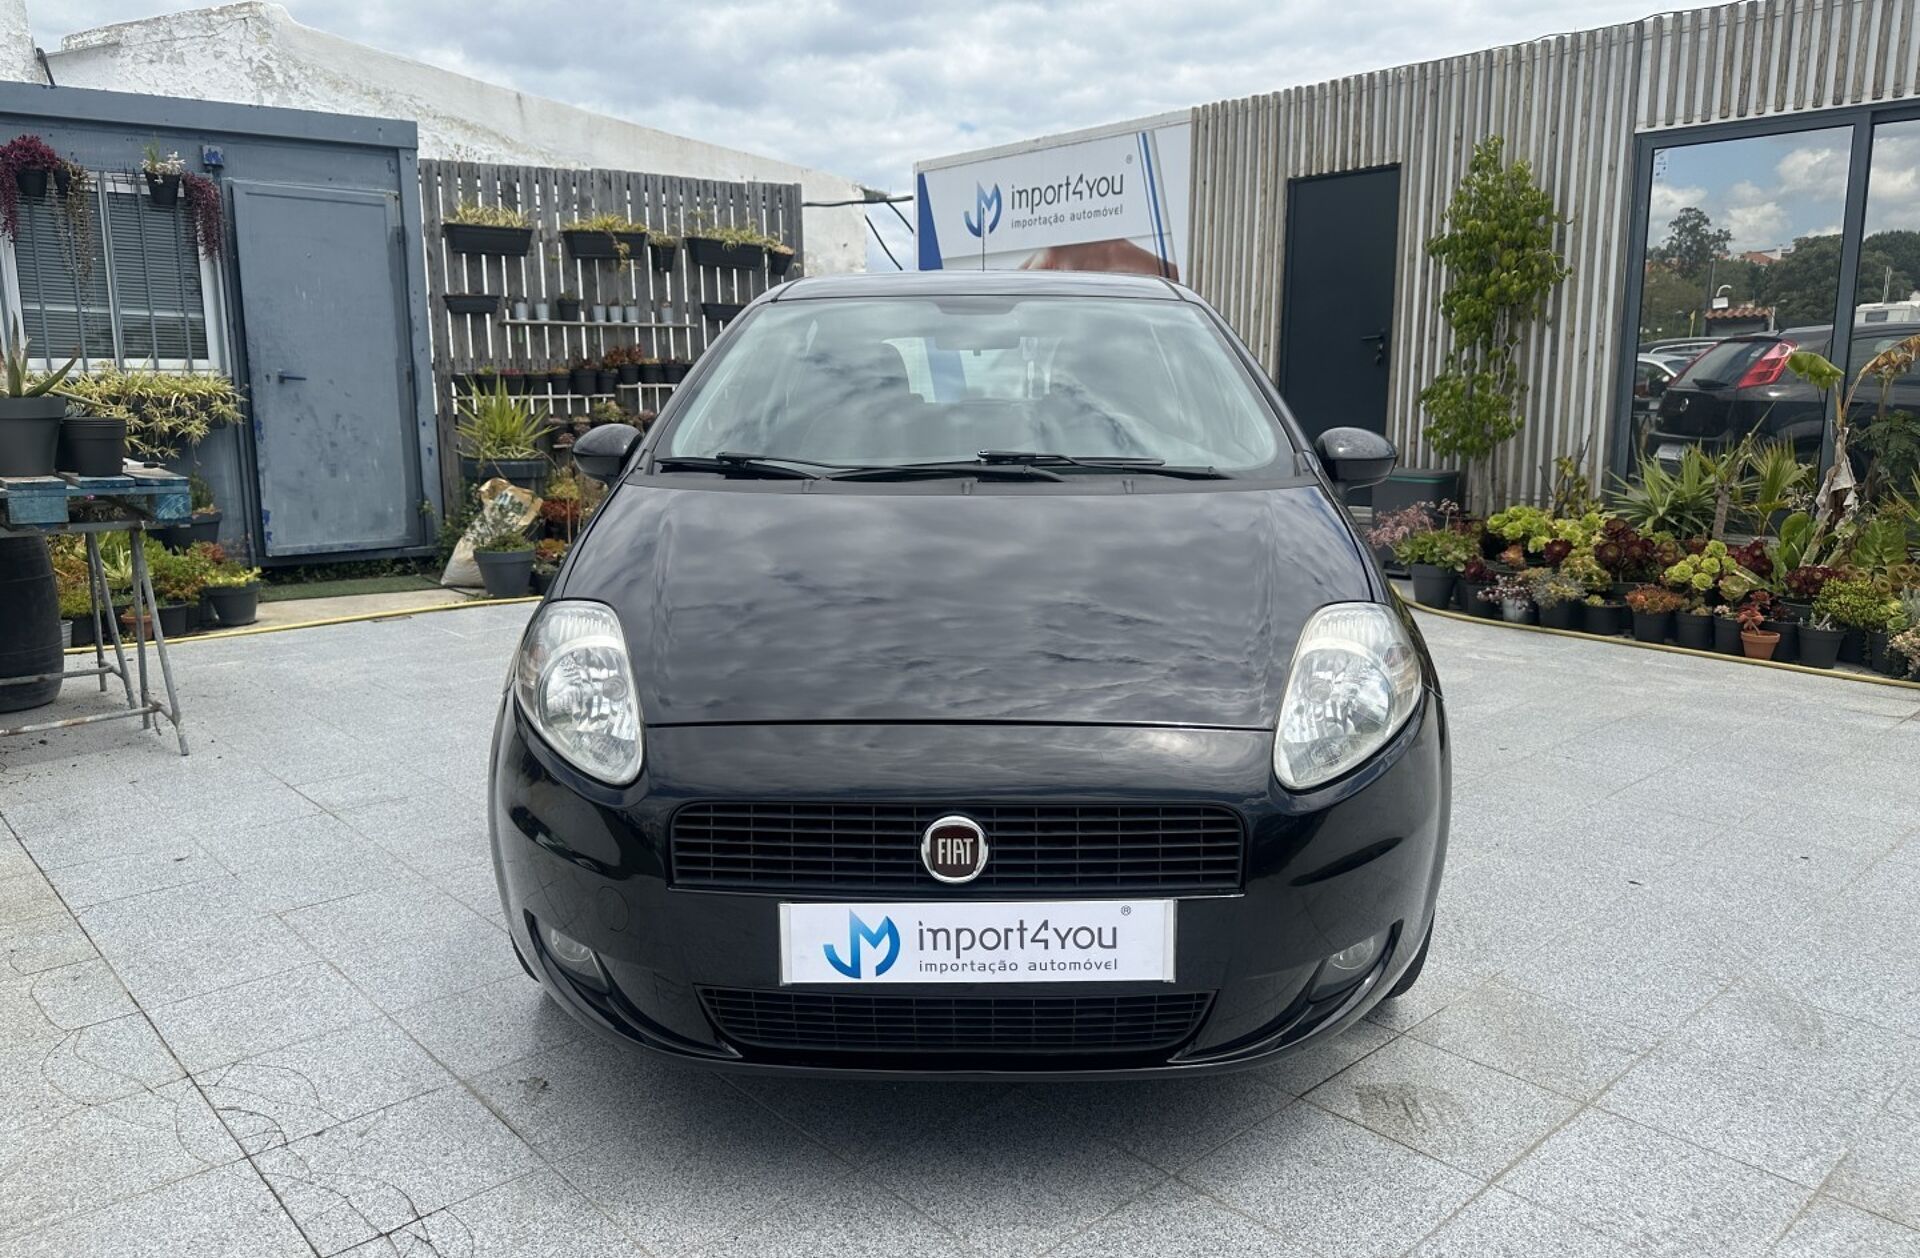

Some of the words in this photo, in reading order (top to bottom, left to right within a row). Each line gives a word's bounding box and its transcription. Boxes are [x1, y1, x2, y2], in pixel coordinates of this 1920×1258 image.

[1011, 173, 1124, 215] import4you
[1011, 213, 1065, 229] importação
[1070, 204, 1124, 222] automóvel
[937, 838, 974, 865] FIAT
[918, 919, 1117, 959] import4you
[919, 959, 1019, 975] importação
[1027, 957, 1118, 972] automóvel
